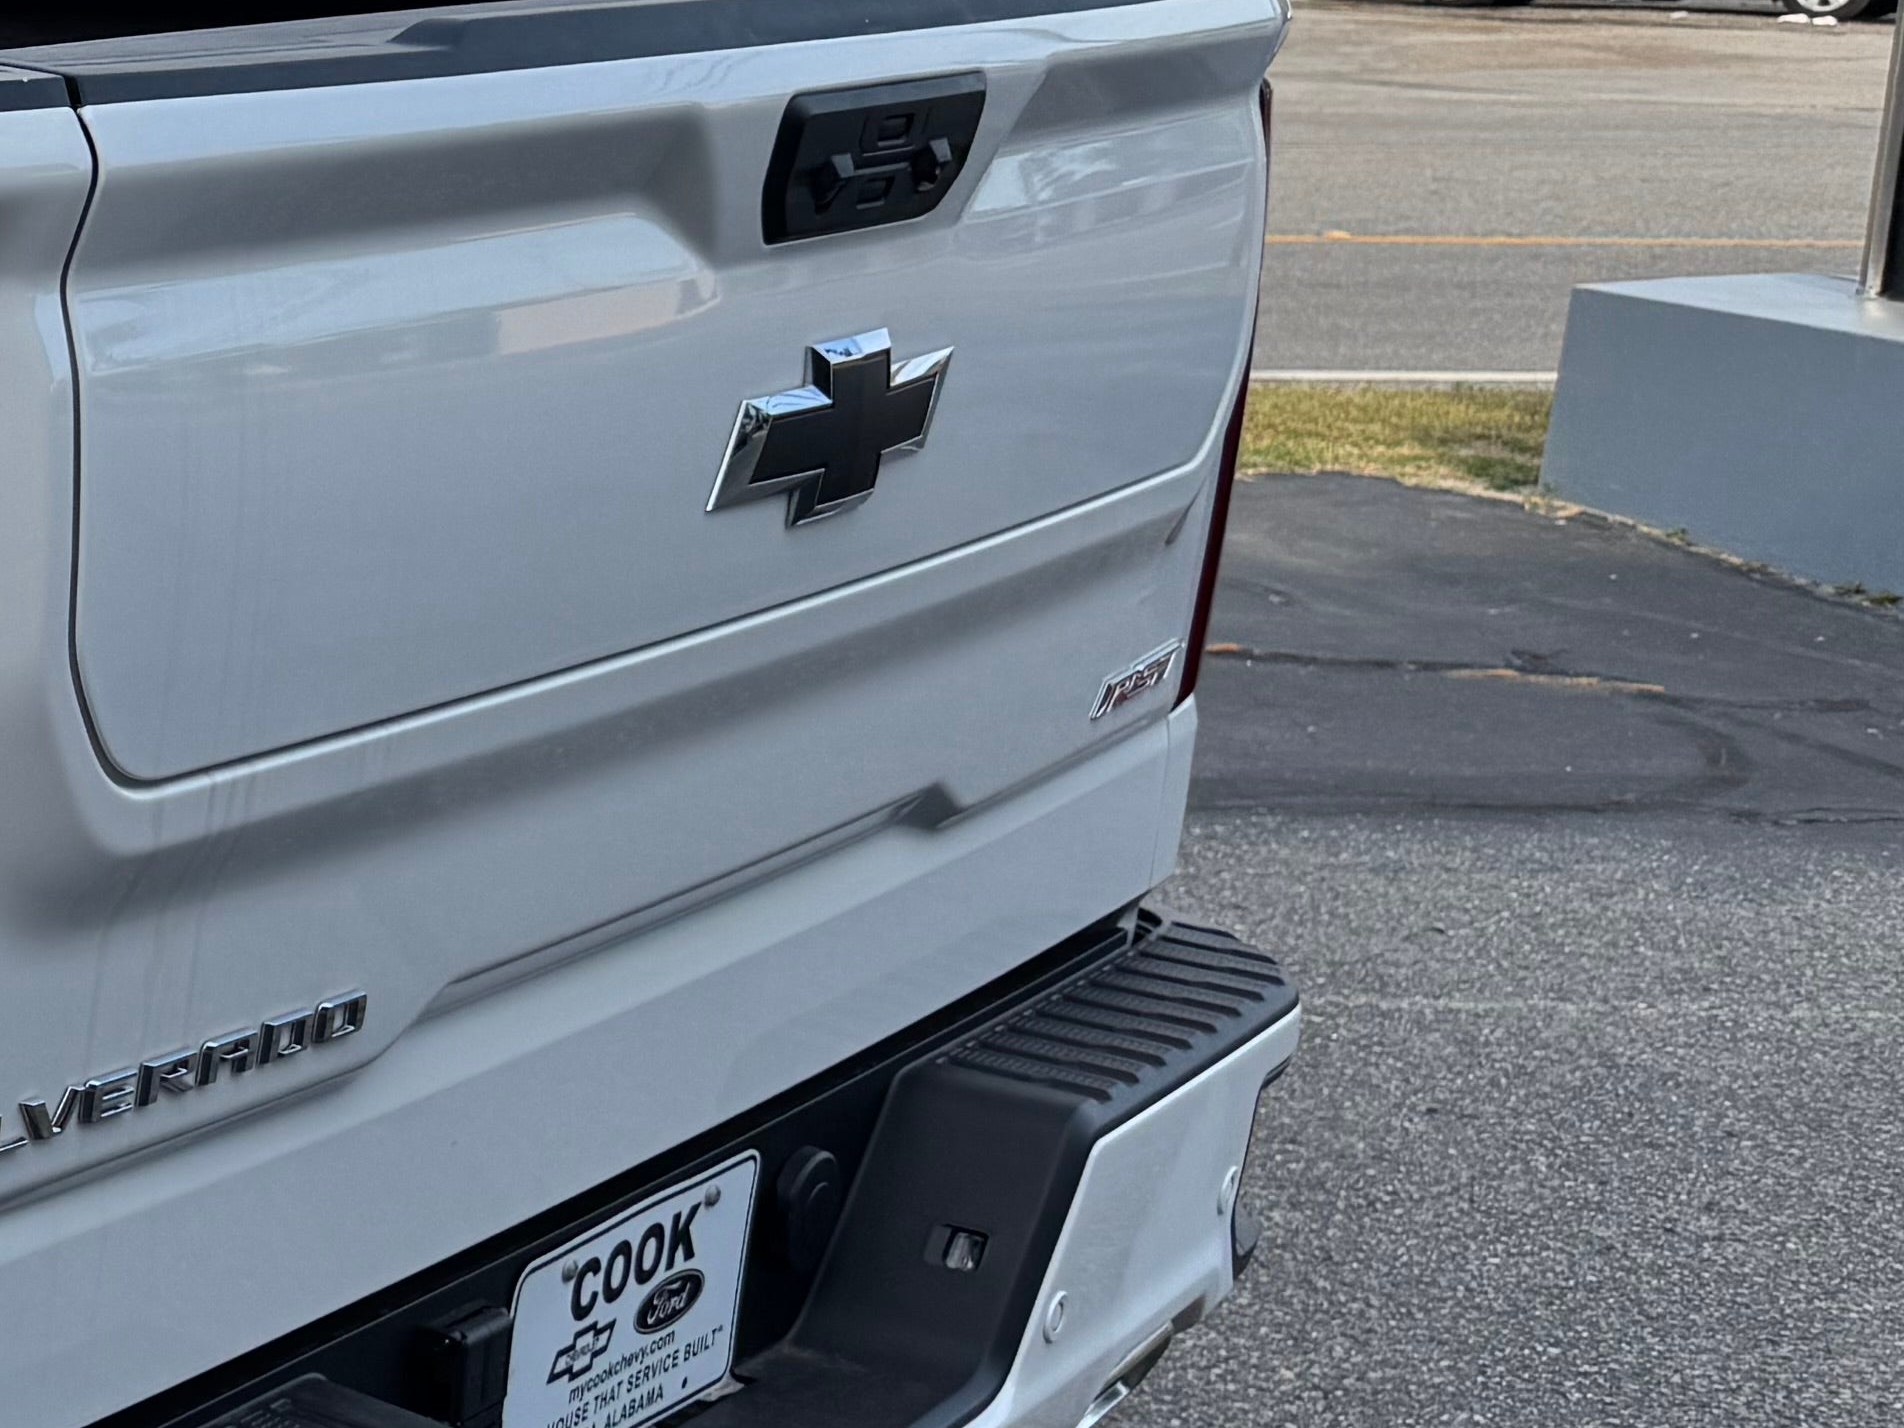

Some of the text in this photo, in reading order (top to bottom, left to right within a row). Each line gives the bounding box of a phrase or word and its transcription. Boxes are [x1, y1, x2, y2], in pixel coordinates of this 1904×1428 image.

[570, 1201, 703, 1322] COOK
[646, 1280, 692, 1326] Ford
[568, 1330, 676, 1405] mycookchevy.com
[593, 1380, 624, 1415] THAT
[626, 1349, 680, 1394] SERVICE
